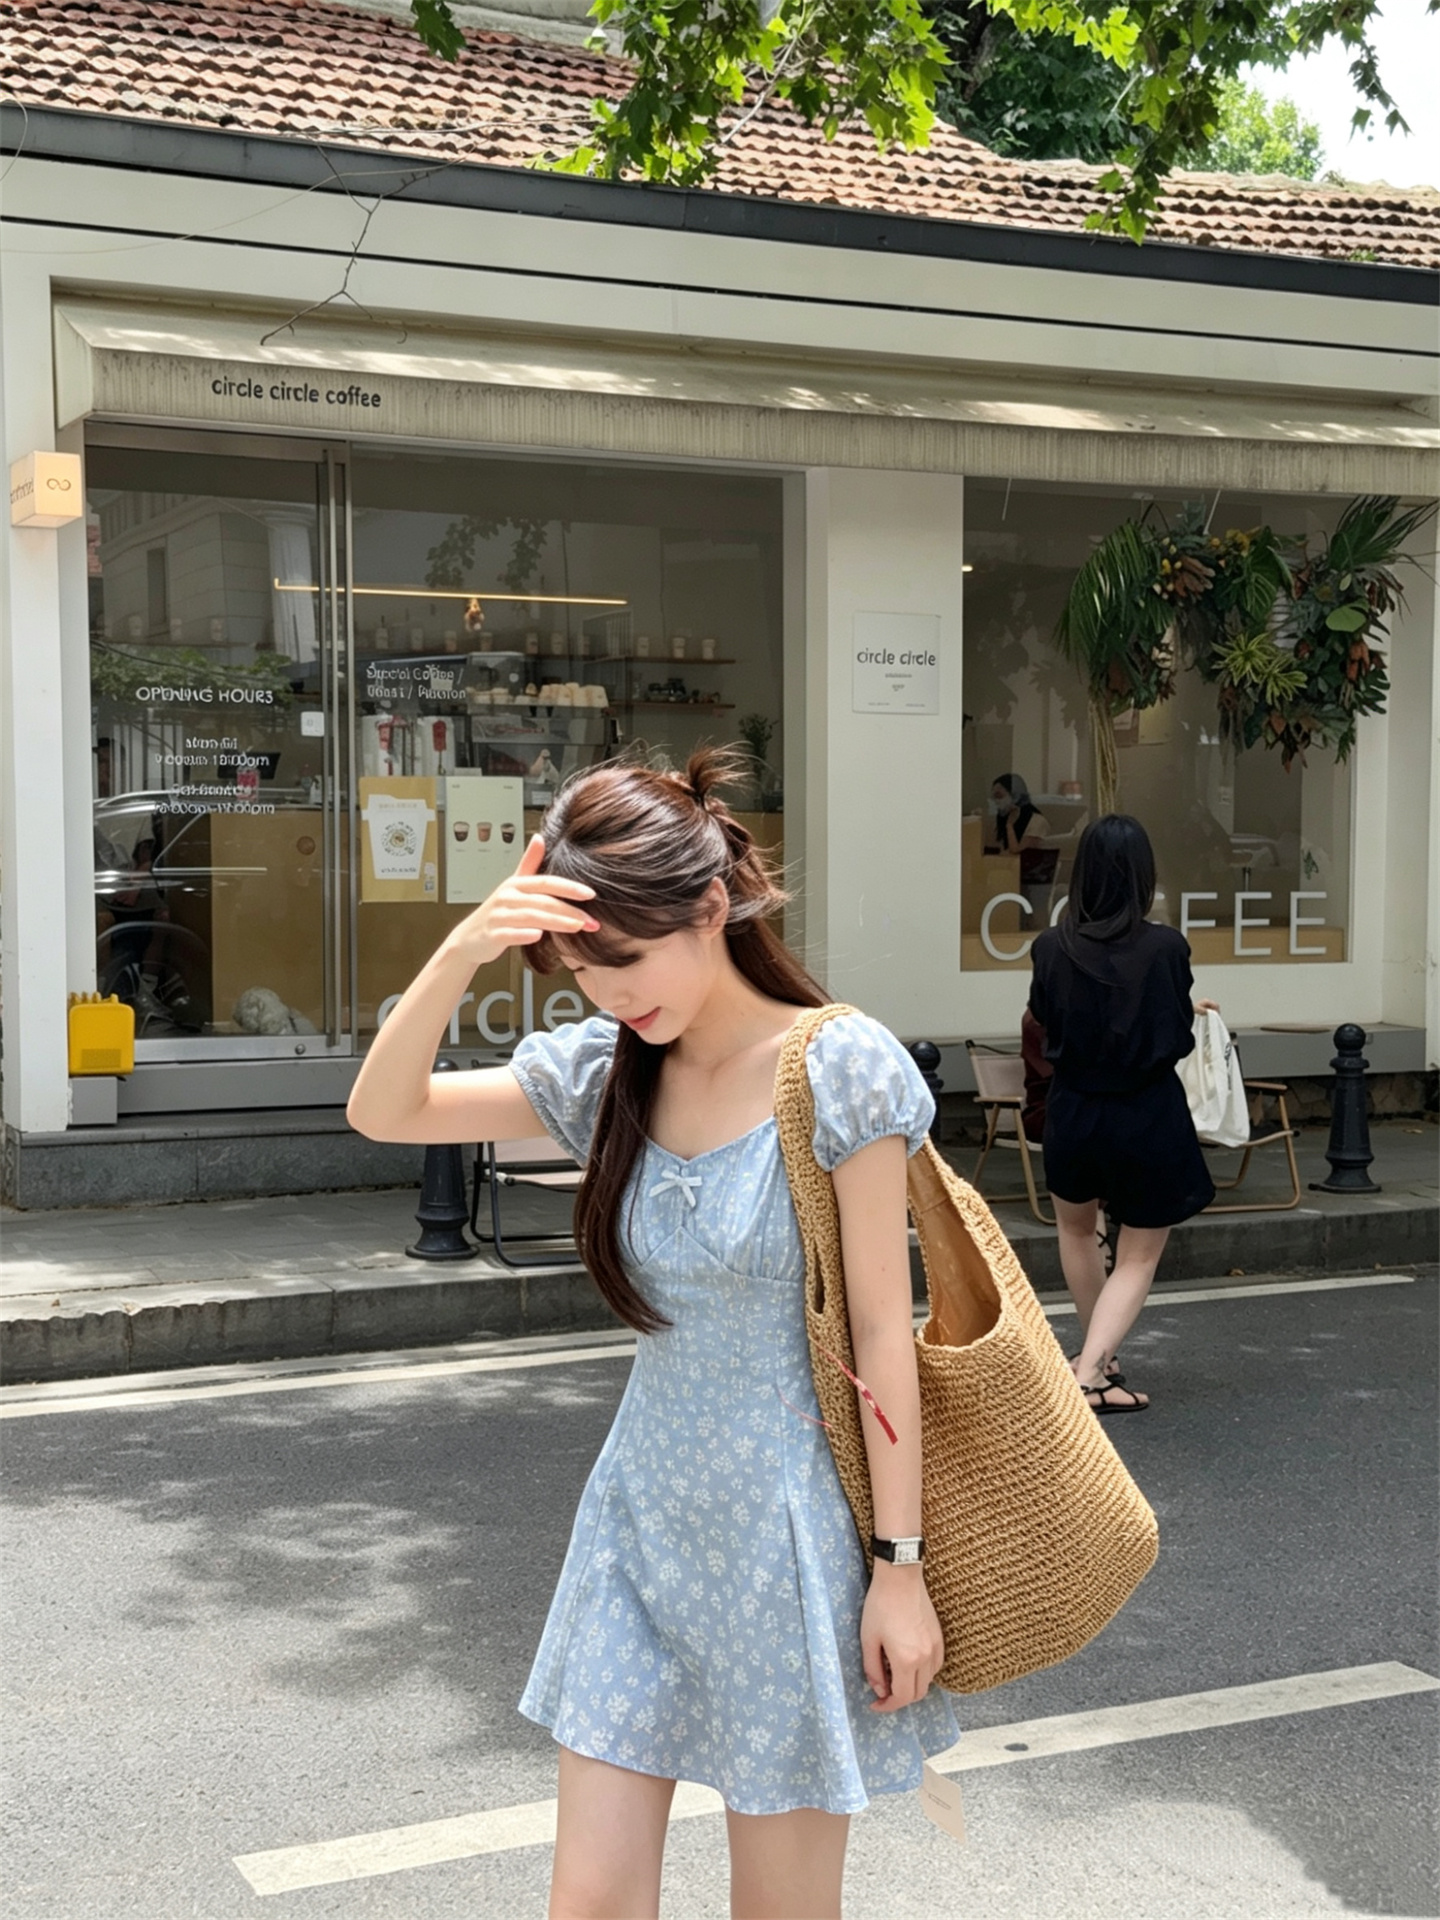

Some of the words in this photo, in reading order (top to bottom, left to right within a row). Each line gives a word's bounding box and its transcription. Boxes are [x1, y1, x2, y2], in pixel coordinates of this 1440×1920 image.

[211, 376, 263, 398] circle
[269, 380, 320, 403] circle
[325, 384, 382, 408] coffee
[857, 647, 895, 665] circle
[899, 649, 936, 666] circle
[218, 687, 273, 704] HOURS
[980, 891, 1328, 962] CFEE
